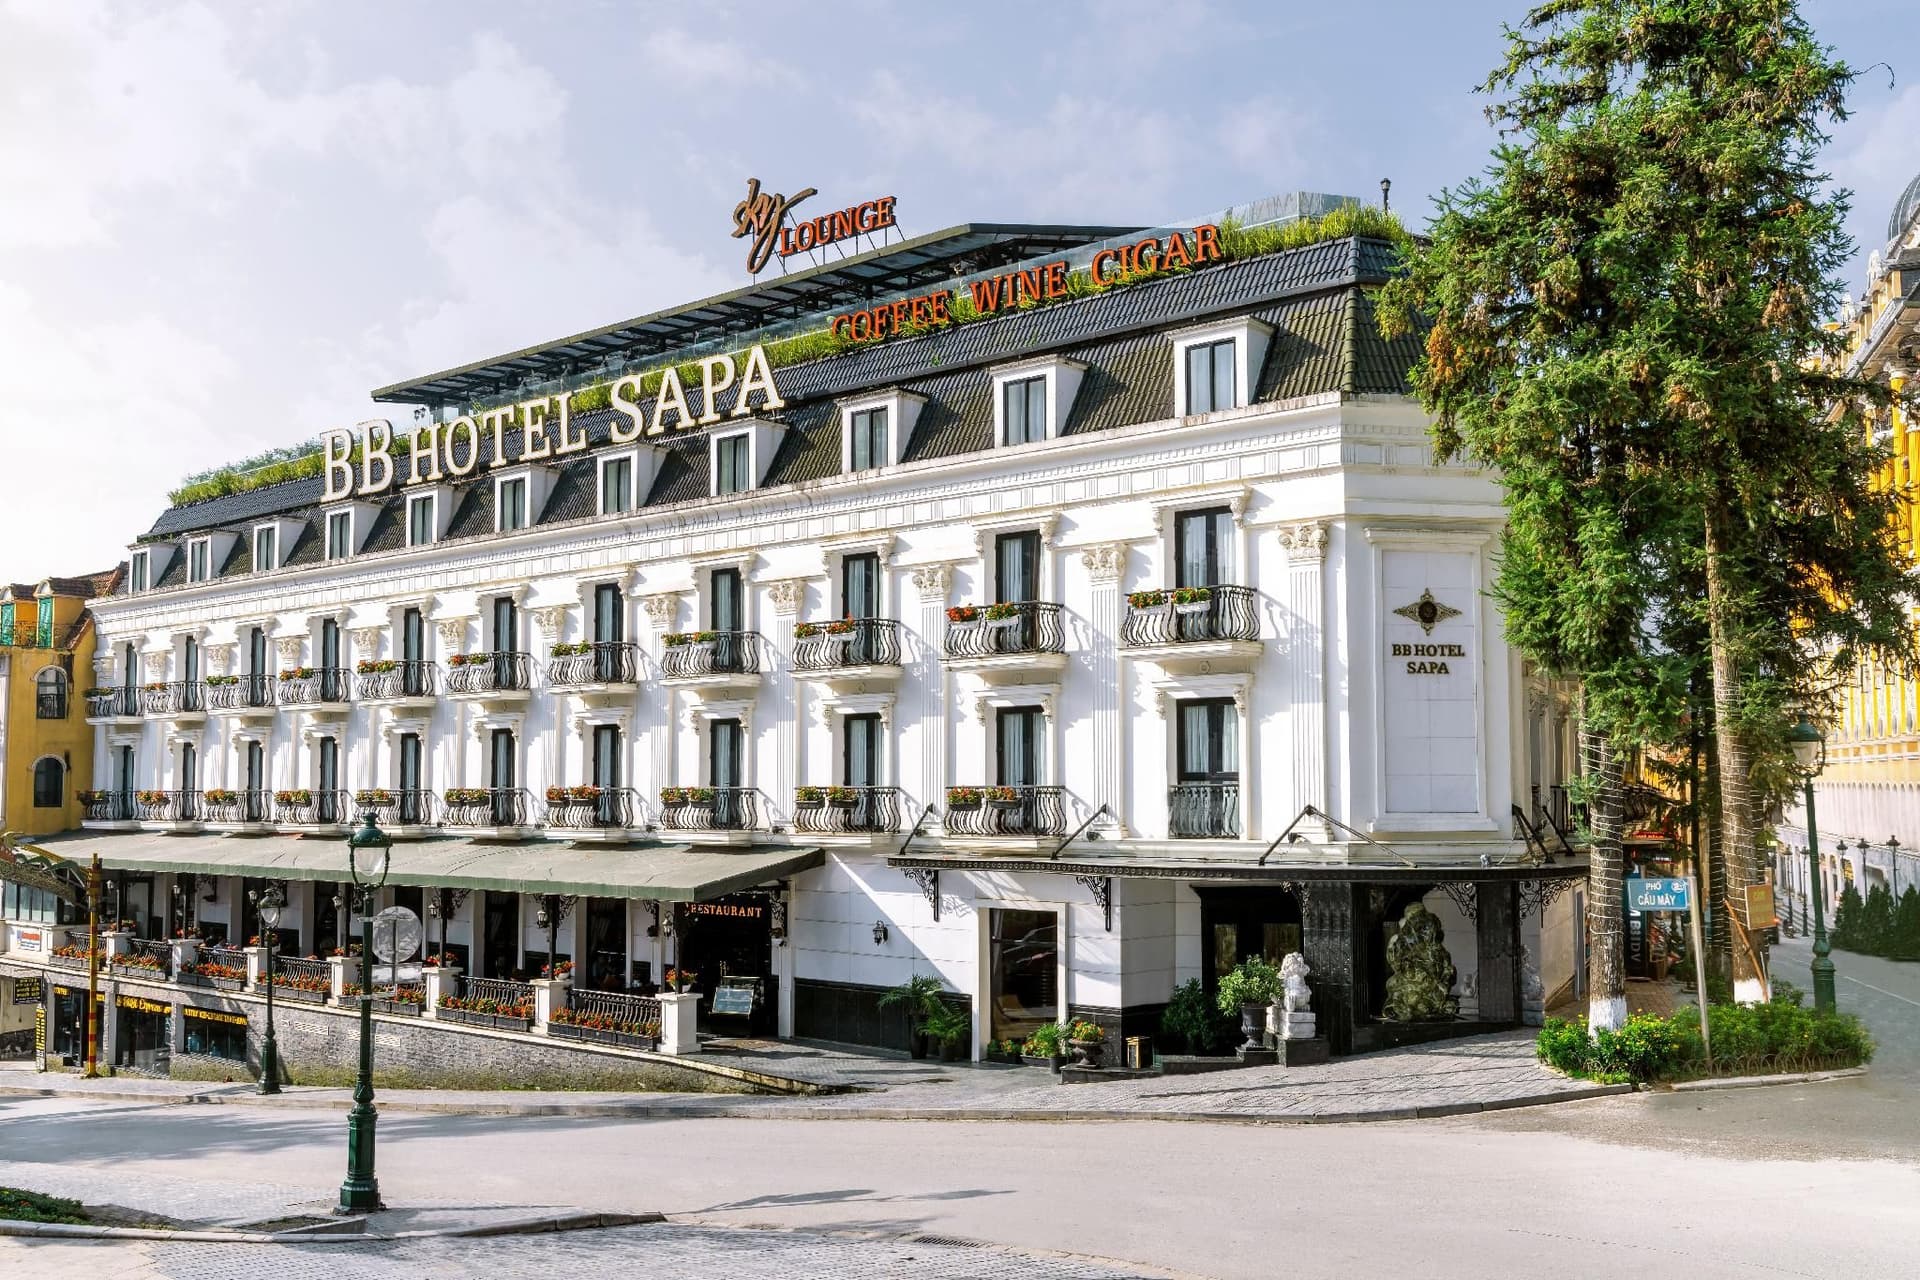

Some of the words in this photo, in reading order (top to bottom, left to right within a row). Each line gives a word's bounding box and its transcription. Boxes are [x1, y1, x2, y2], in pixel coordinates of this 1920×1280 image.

[779, 195, 897, 257] LOUNGE
[832, 290, 954, 342] COFFEE
[969, 261, 1069, 313] WINE
[1091, 224, 1222, 287] CIGAR
[320, 418, 394, 502] BB
[406, 390, 588, 485] HOTEL
[610, 345, 785, 444] SAPA
[1392, 643, 1411, 657] BB
[1413, 644, 1465, 658] HOTEL
[1407, 661, 1449, 675] SAPA
[1645, 879, 1662, 891] PHỐ
[691, 904, 762, 918] RESTAURANT
